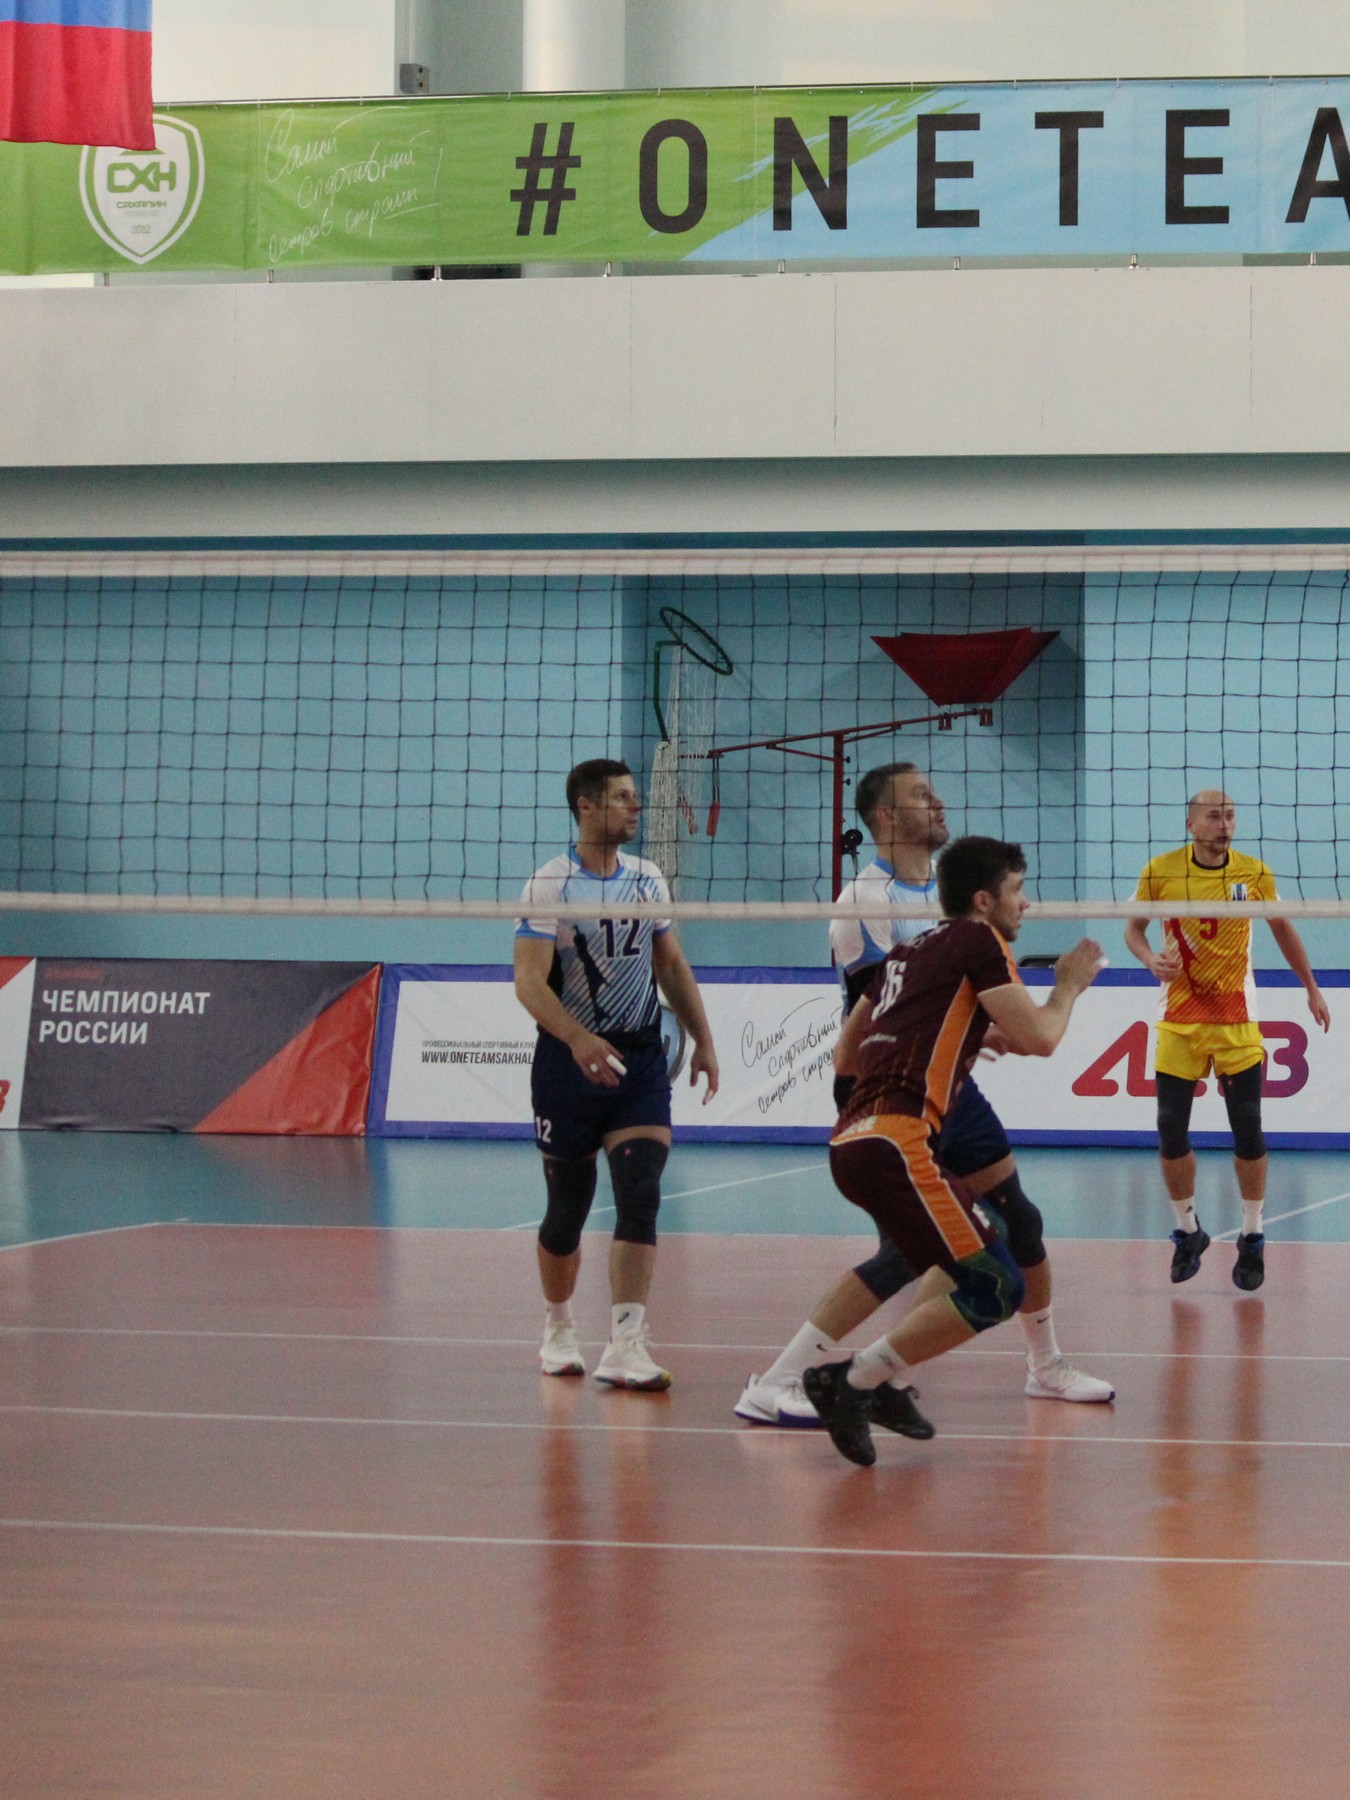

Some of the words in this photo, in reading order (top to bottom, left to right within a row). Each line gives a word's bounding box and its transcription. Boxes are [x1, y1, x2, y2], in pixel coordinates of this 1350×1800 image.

[42, 989, 211, 1015] ЧЕМПИОНАТ
[38, 1020, 149, 1045] РОССИИ
[421, 1051, 534, 1065] WWW.ONETEAMSAKHAL
[535, 1115, 552, 1143] 12
